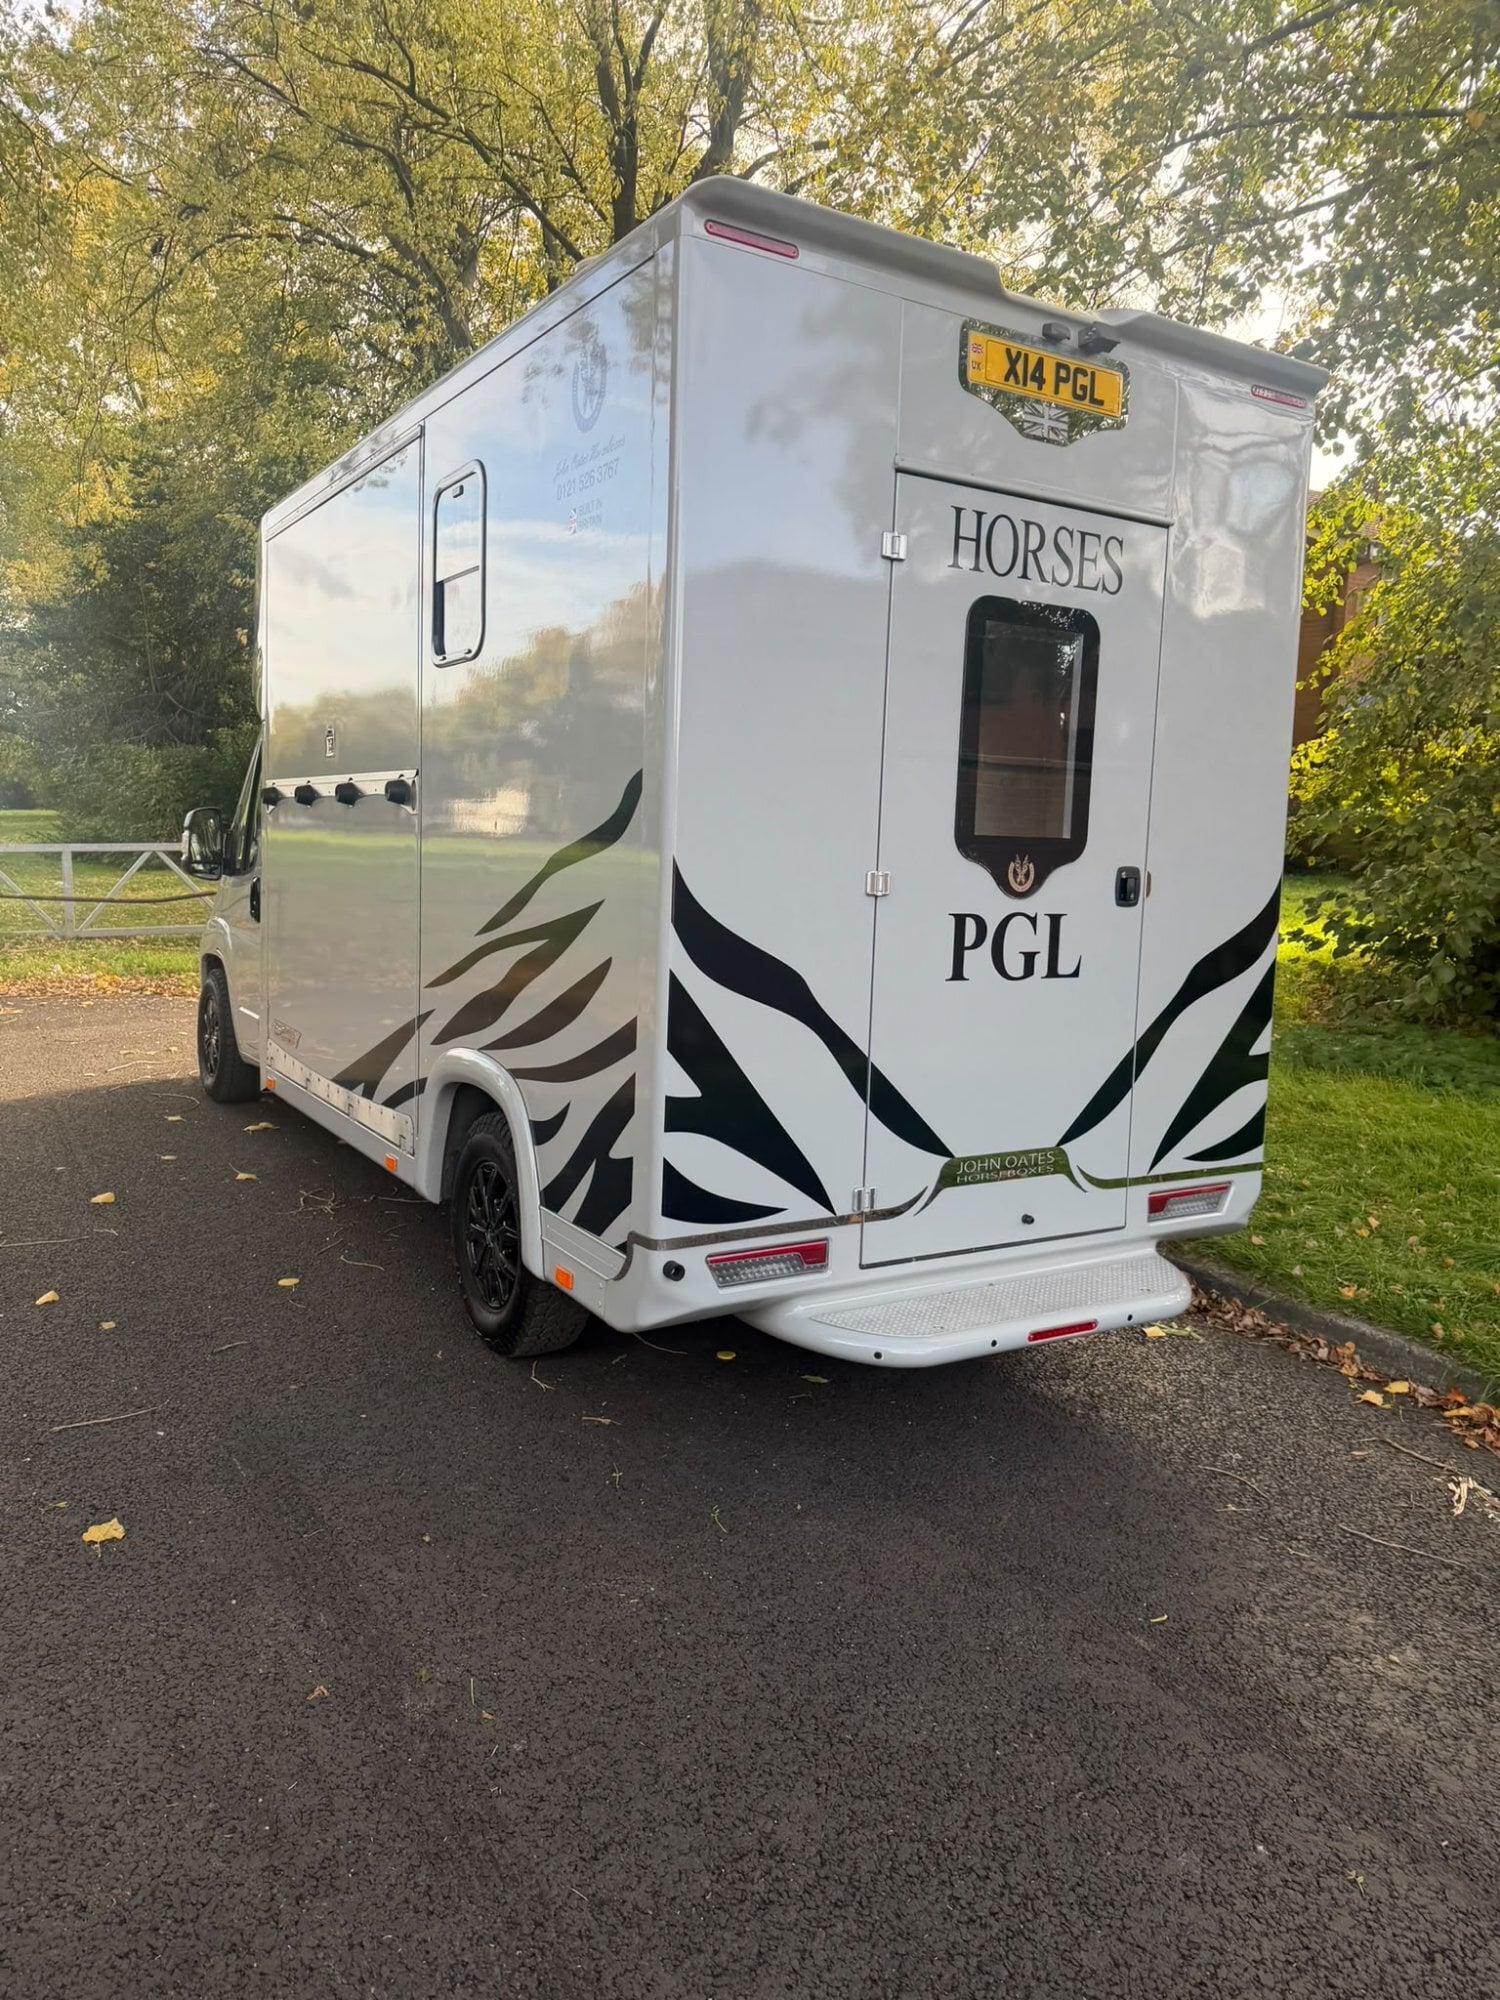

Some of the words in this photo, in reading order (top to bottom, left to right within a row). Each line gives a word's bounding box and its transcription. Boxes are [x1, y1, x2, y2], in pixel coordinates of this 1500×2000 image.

[971, 360, 981, 372] UK
[1004, 347, 1046, 391] X14
[1053, 361, 1105, 407] PGL
[556, 478, 576, 501] 0121
[947, 505, 1124, 595] HORSES
[945, 912, 1082, 981] PGL
[956, 1157, 1000, 1175] JOHN
[1005, 1151, 1055, 1168] OATES
[956, 1165, 1054, 1184] HORSEBOXES
